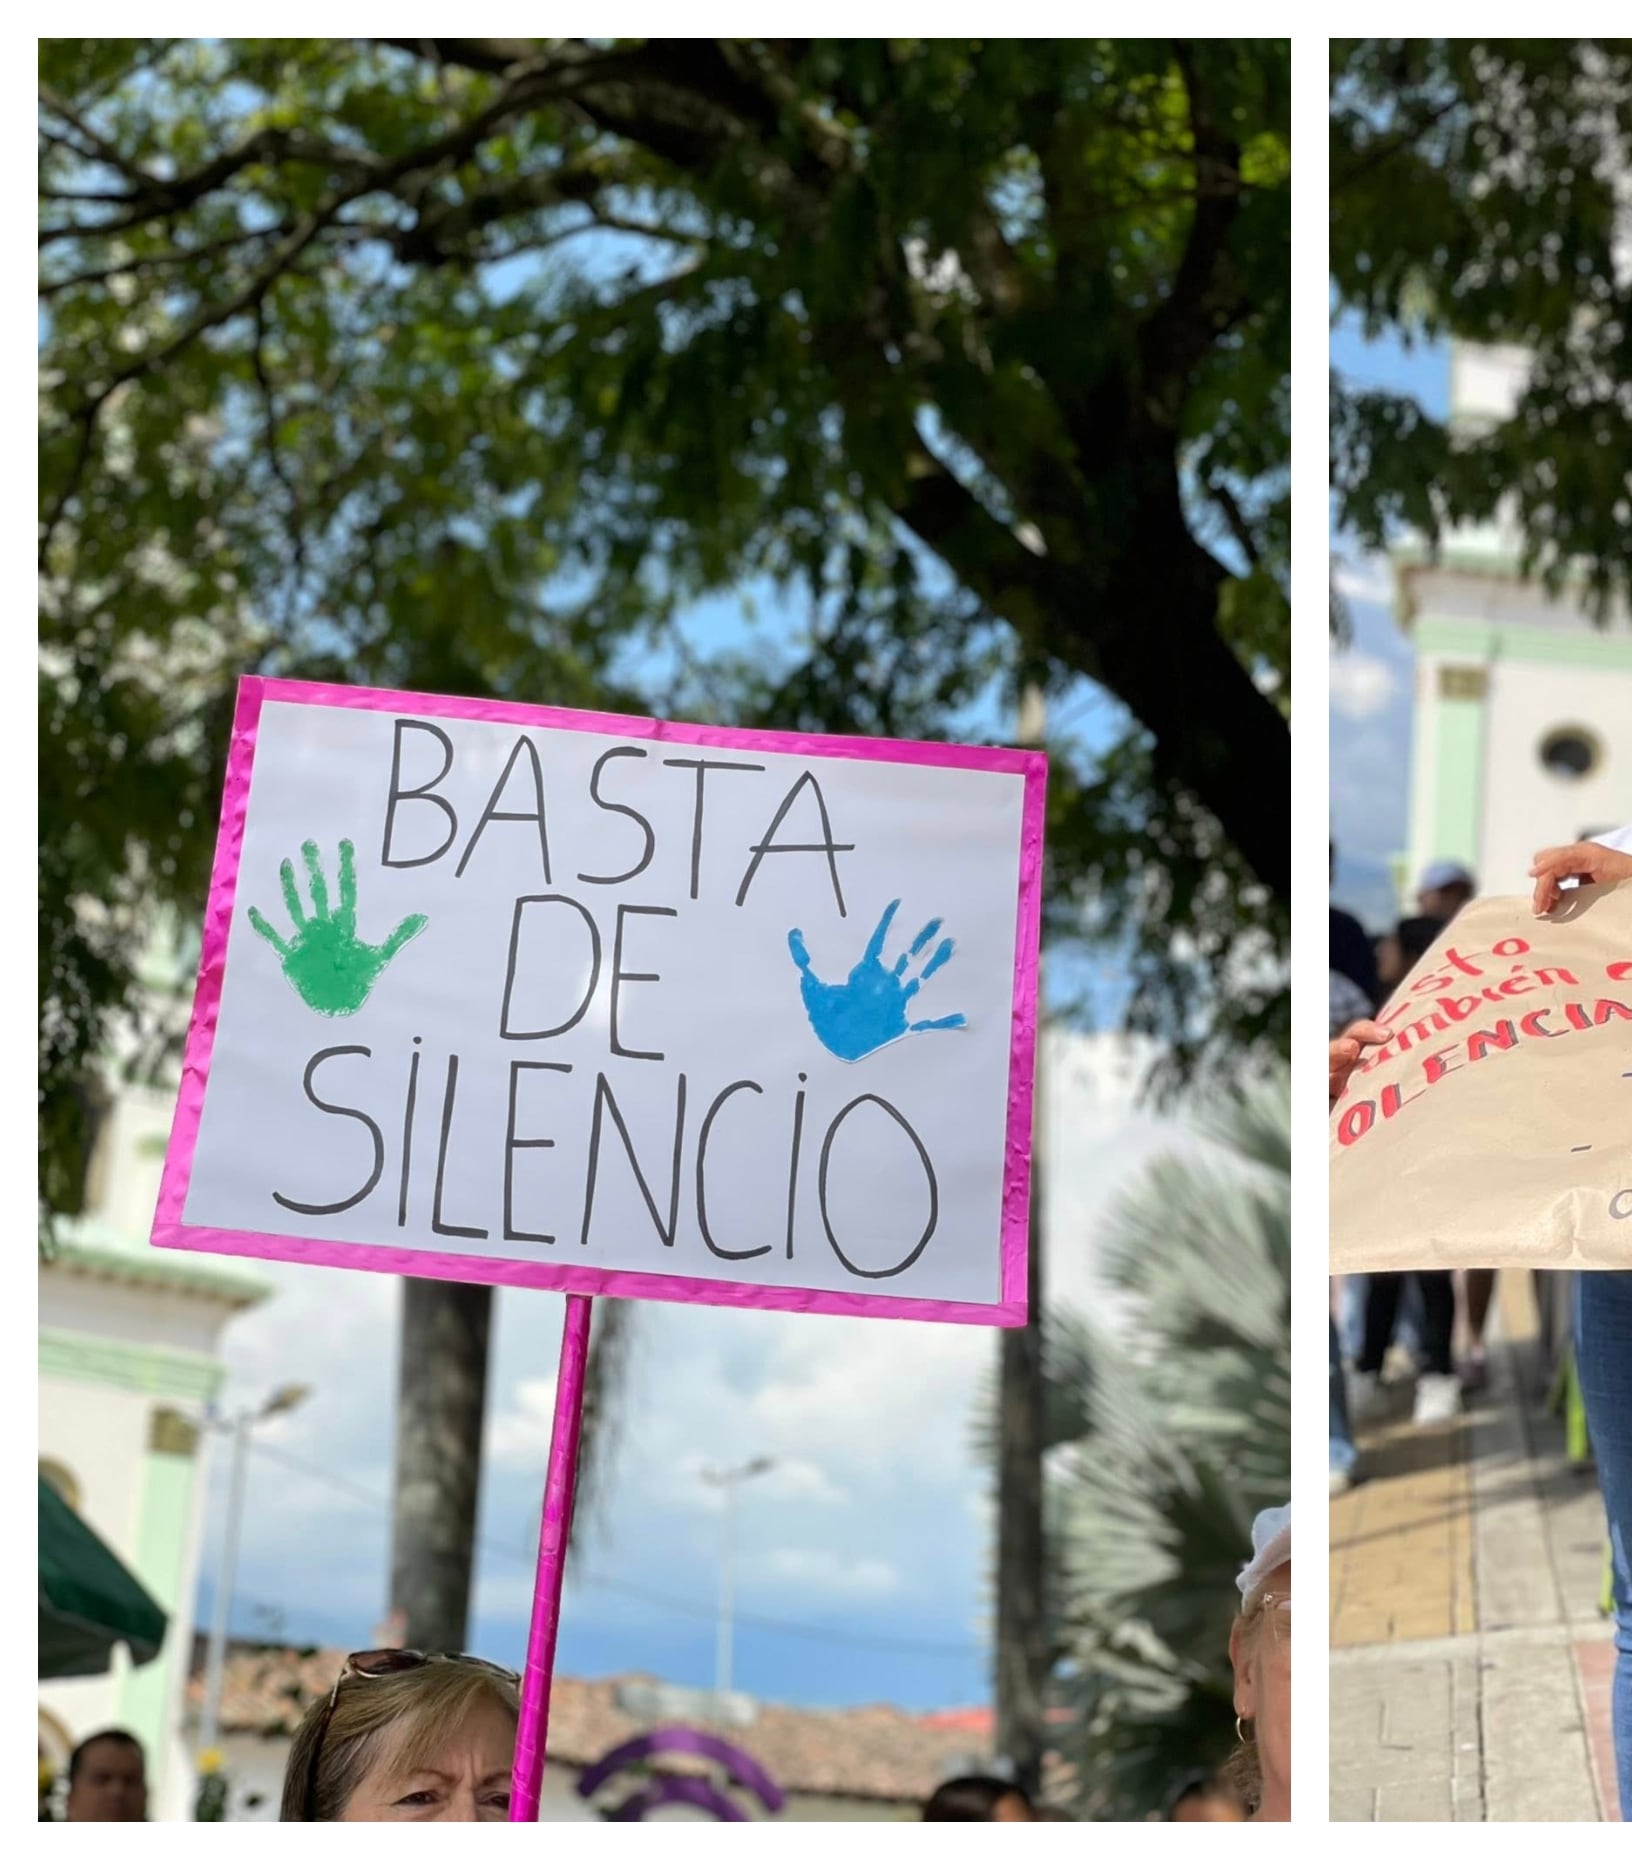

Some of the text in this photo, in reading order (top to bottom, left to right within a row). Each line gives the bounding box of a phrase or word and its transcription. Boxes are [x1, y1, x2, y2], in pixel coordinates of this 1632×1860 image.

[380, 718, 856, 918] BASTA
[498, 893, 679, 1061] DE
[271, 1036, 940, 1280] SILENCIO
